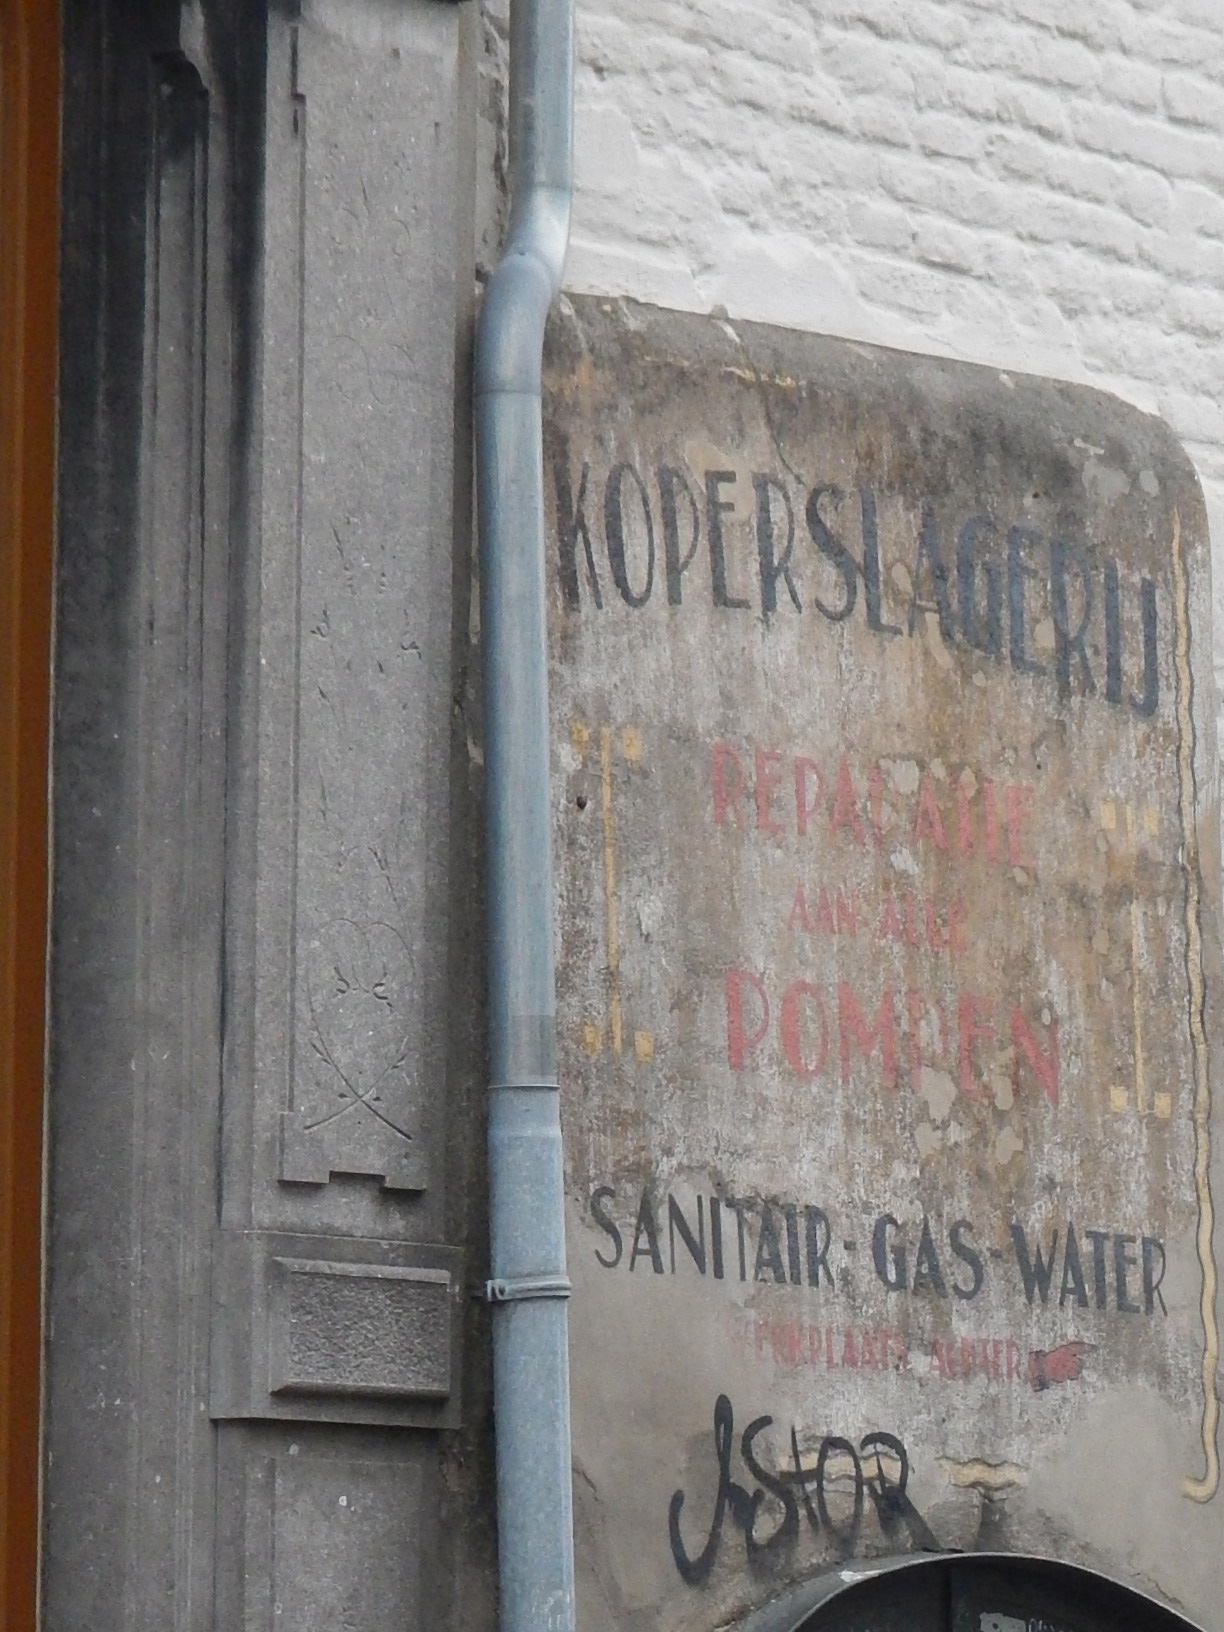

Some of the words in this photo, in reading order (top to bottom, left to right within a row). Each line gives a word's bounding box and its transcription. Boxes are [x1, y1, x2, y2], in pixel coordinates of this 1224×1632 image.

[555, 461, 1159, 717] KOPERSLAGERIJ
[725, 968, 1059, 1107] POMPEN
[590, 1185, 835, 1288] SANITAIR
[873, 1213, 984, 1300] GAS
[1010, 1221, 1168, 1317] WATER
